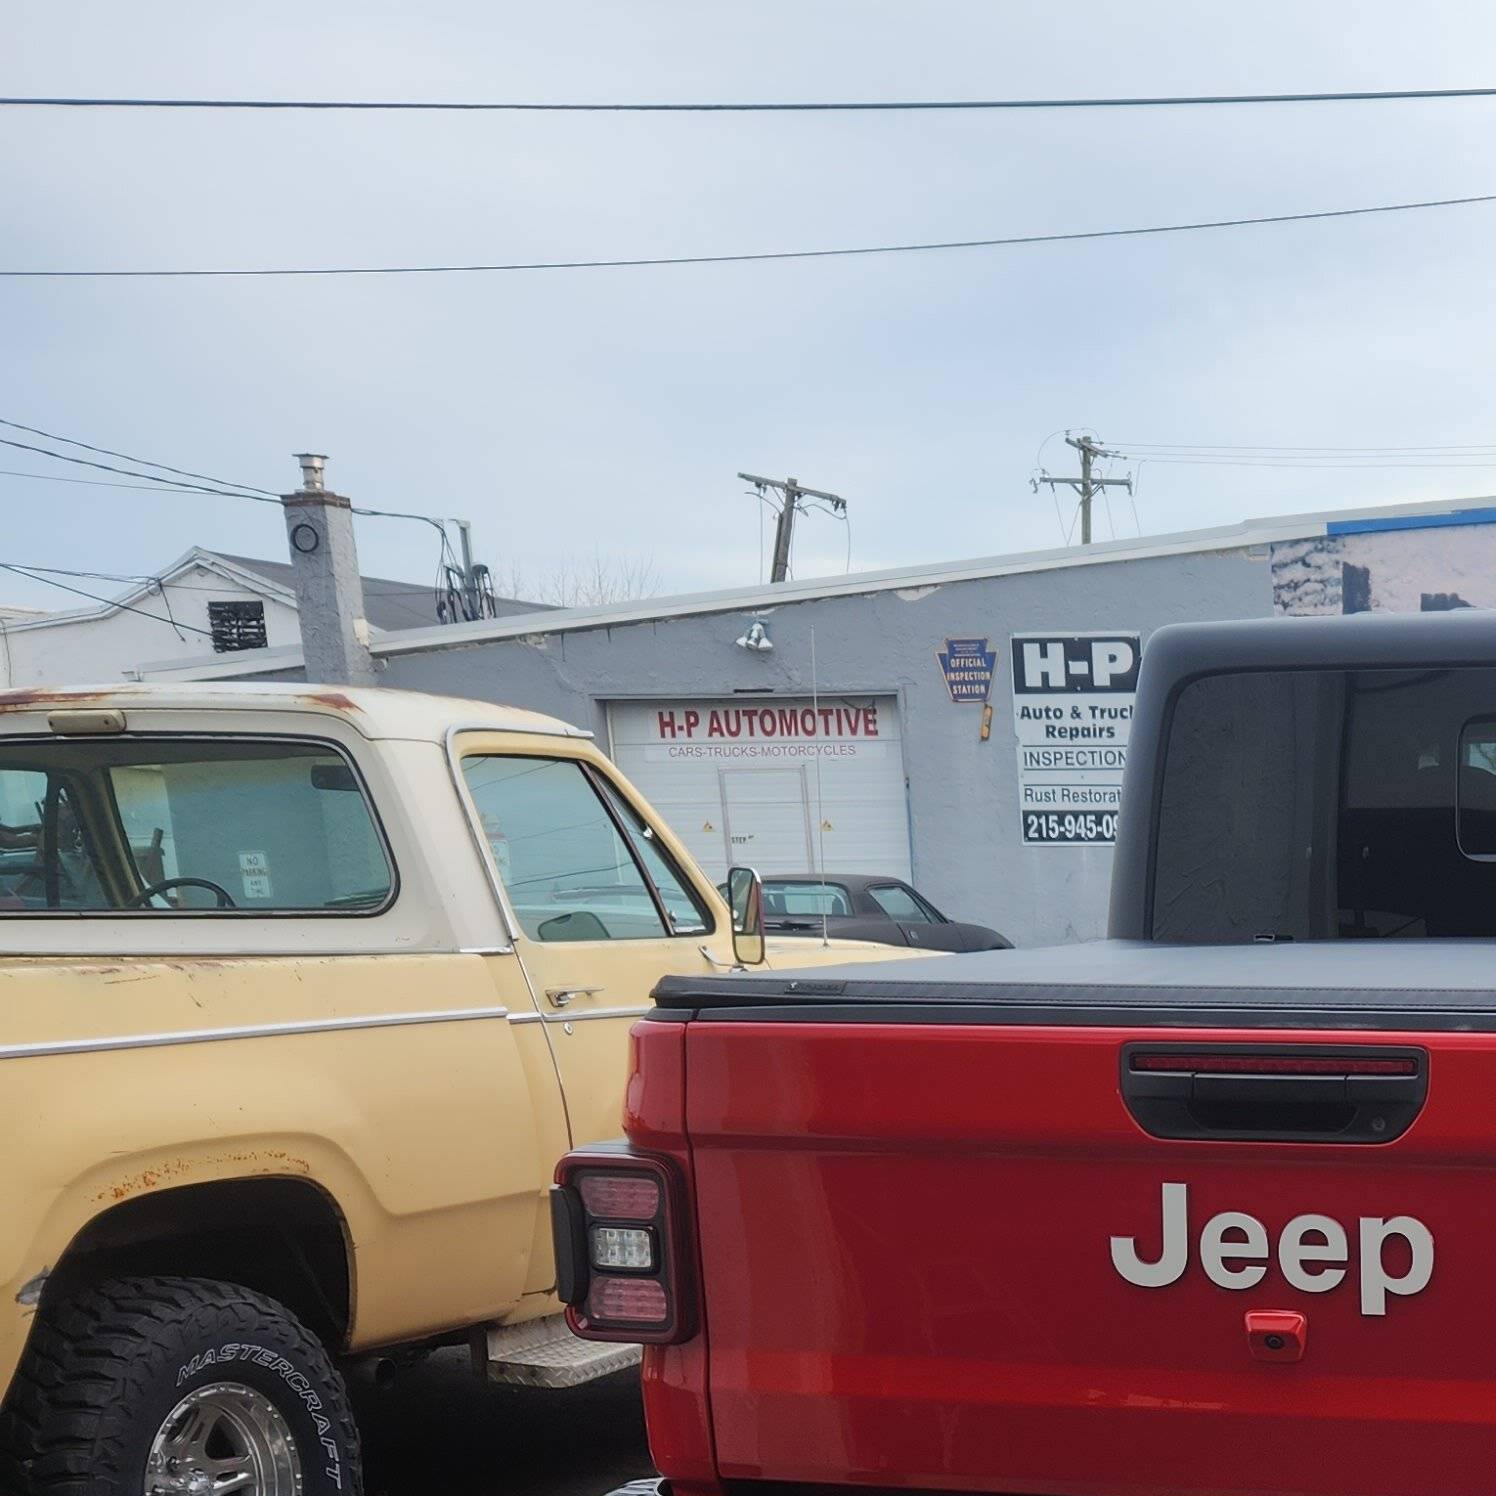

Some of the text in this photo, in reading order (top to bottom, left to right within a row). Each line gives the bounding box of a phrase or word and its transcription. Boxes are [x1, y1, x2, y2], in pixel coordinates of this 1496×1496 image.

[950, 658, 987, 668] OFFICIAL
[1023, 642, 1133, 687] H-P
[946, 672, 991, 681] INSPECTION
[952, 685, 986, 694] STATION
[1020, 705, 1063, 720] Auto
[1070, 705, 1082, 720] &
[658, 708, 879, 739] H-P AUTOMOTIVE
[1045, 724, 1115, 740] Repairs
[668, 744, 857, 759] CARS-TRUCKS-MOTORCYCLES
[1024, 788, 1056, 803] Rust
[1110, 1182, 1435, 1316] Jeep
[175, 1343, 343, 1490] MASTERCRAFT
